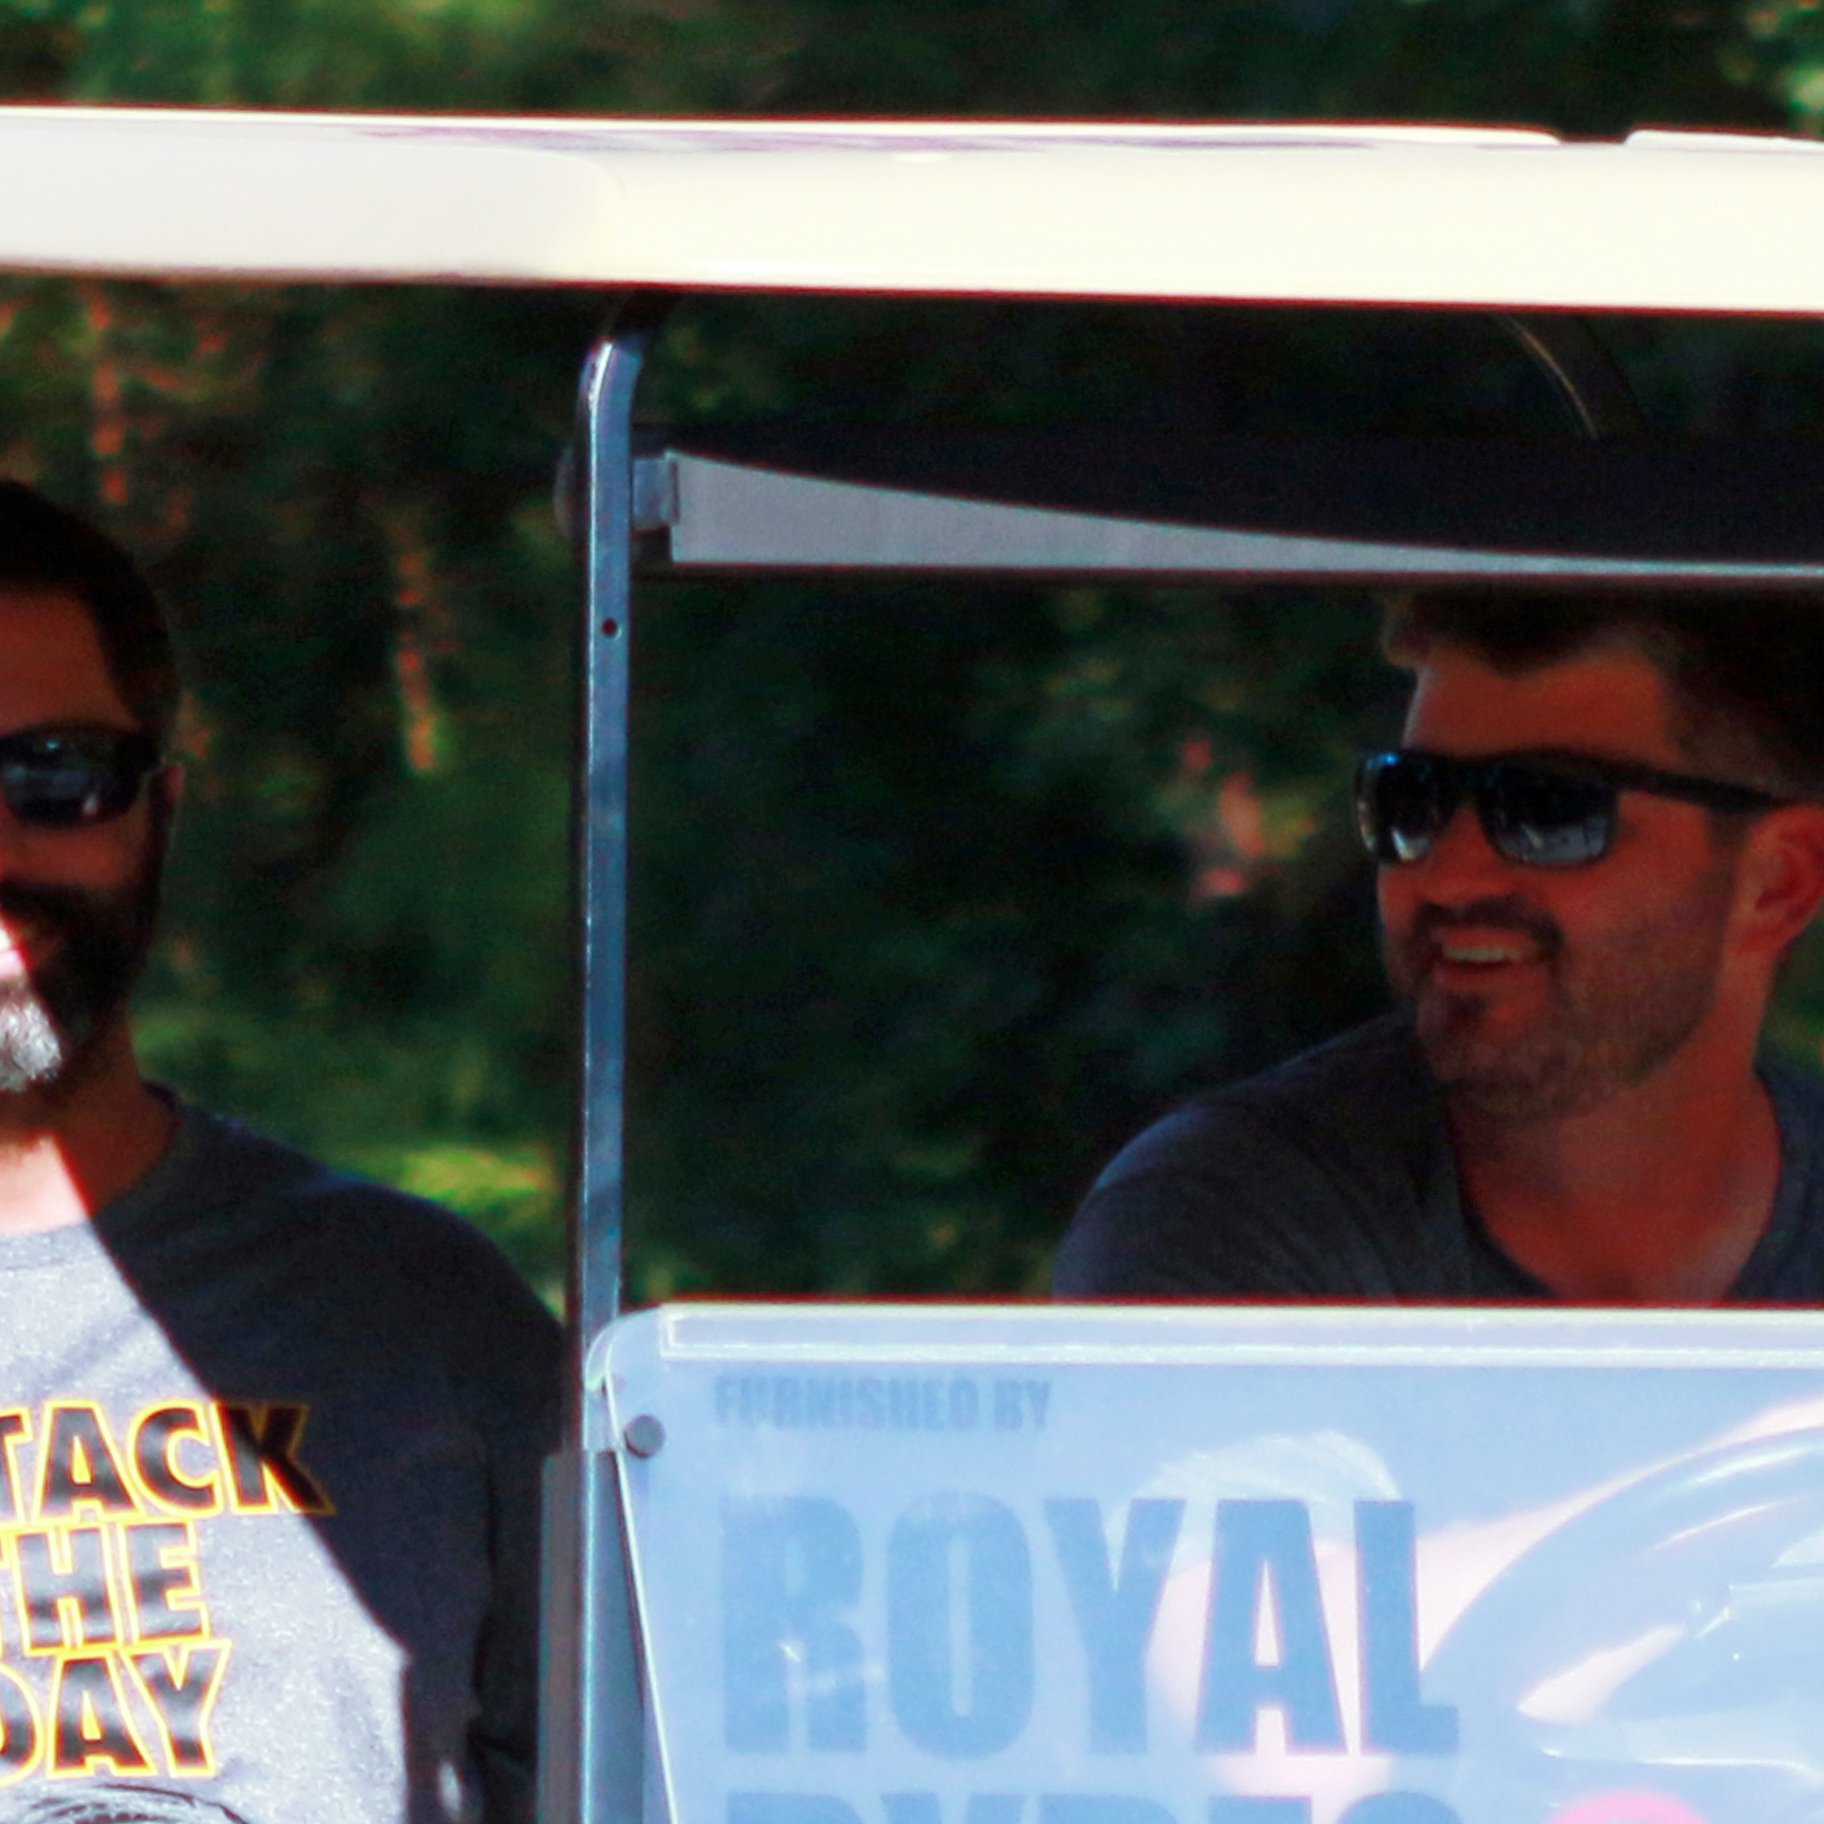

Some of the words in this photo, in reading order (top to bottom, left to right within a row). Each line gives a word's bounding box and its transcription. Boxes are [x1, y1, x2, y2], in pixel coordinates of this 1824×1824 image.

[713, 1374, 979, 1431] FURNISHED
[994, 1377, 1052, 1433] BY
[718, 1492, 1460, 1760] ROYAL
